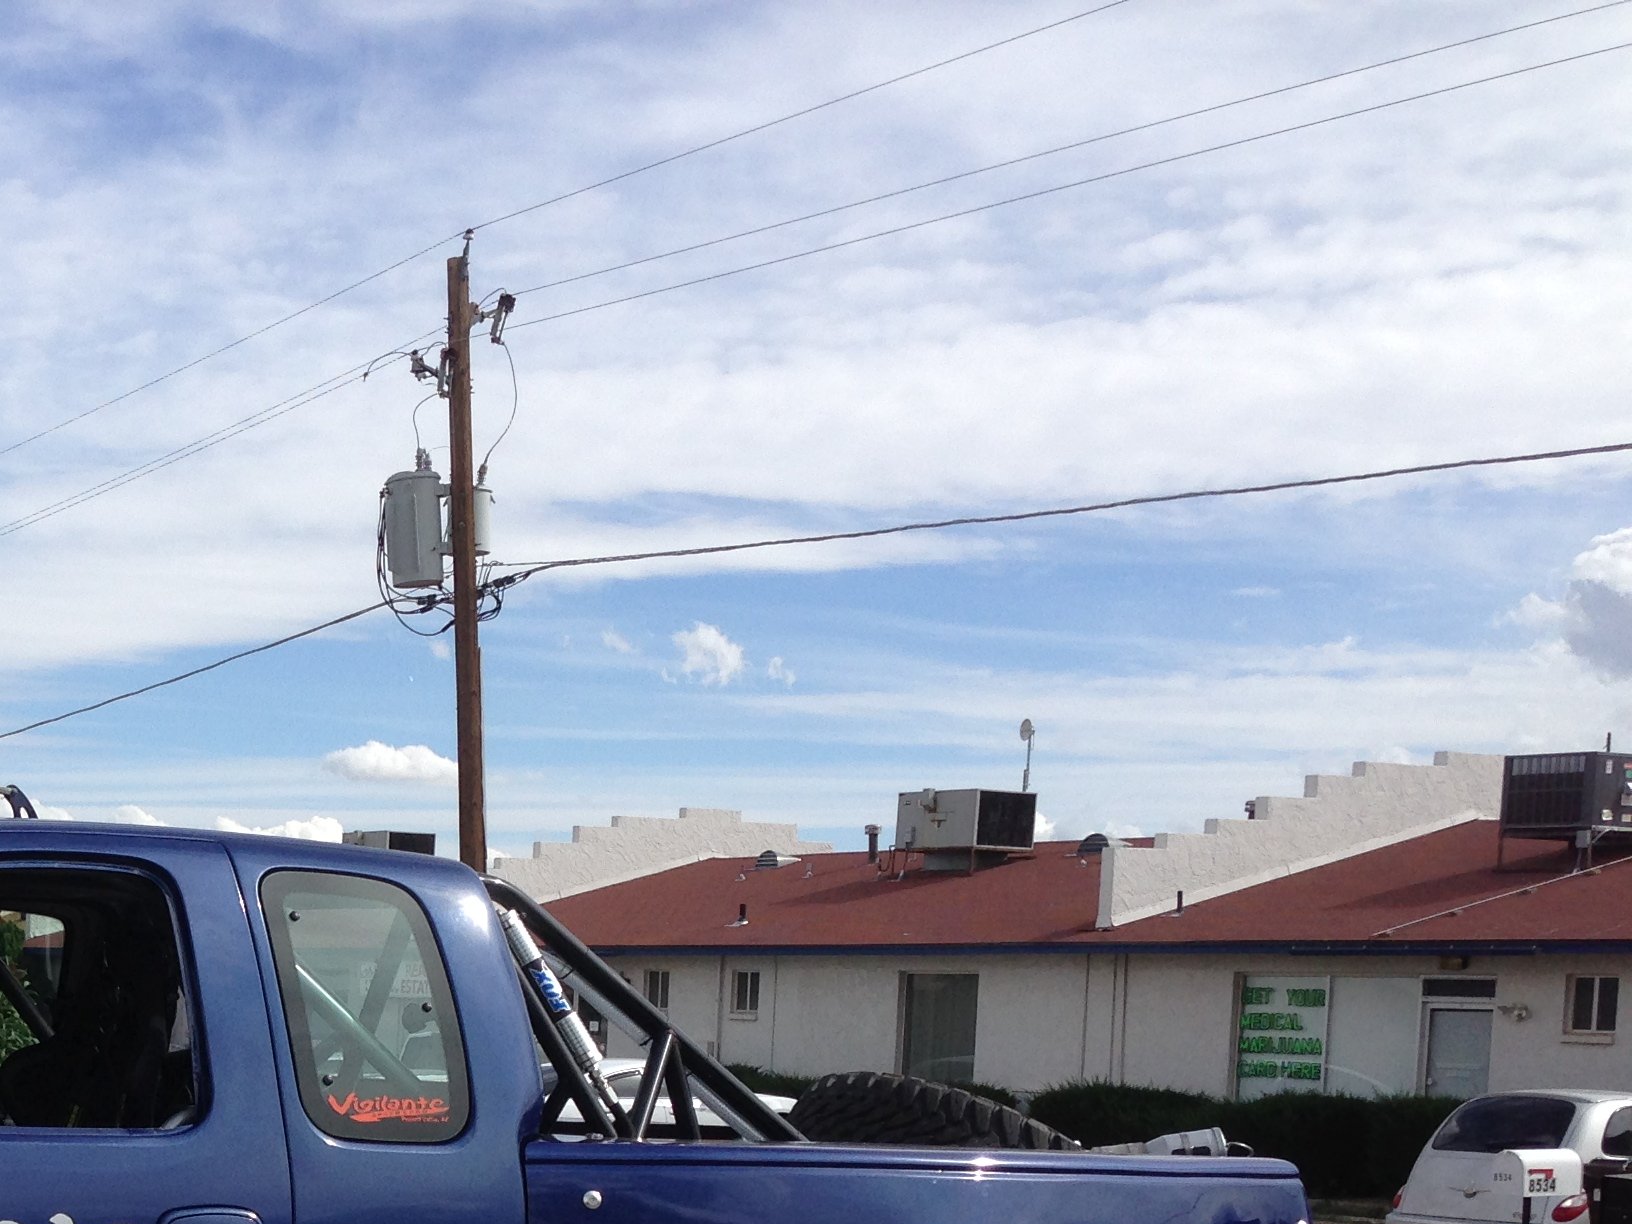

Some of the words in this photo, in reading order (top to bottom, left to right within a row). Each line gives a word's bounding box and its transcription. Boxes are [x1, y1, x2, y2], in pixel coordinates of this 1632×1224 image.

[529, 960, 571, 1012] FOX
[1243, 987, 1275, 1005] GET
[1287, 988, 1326, 1007] YOUR
[1240, 1013, 1303, 1031] MEDICAL
[1240, 1036, 1322, 1055] MARIJUANA
[1238, 1060, 1277, 1078] CARD
[1281, 1061, 1321, 1080] HERE
[328, 1092, 445, 1116] Vigilante
[1494, 1173, 1512, 1181] 8534
[1529, 1178, 1556, 1192] 8534
